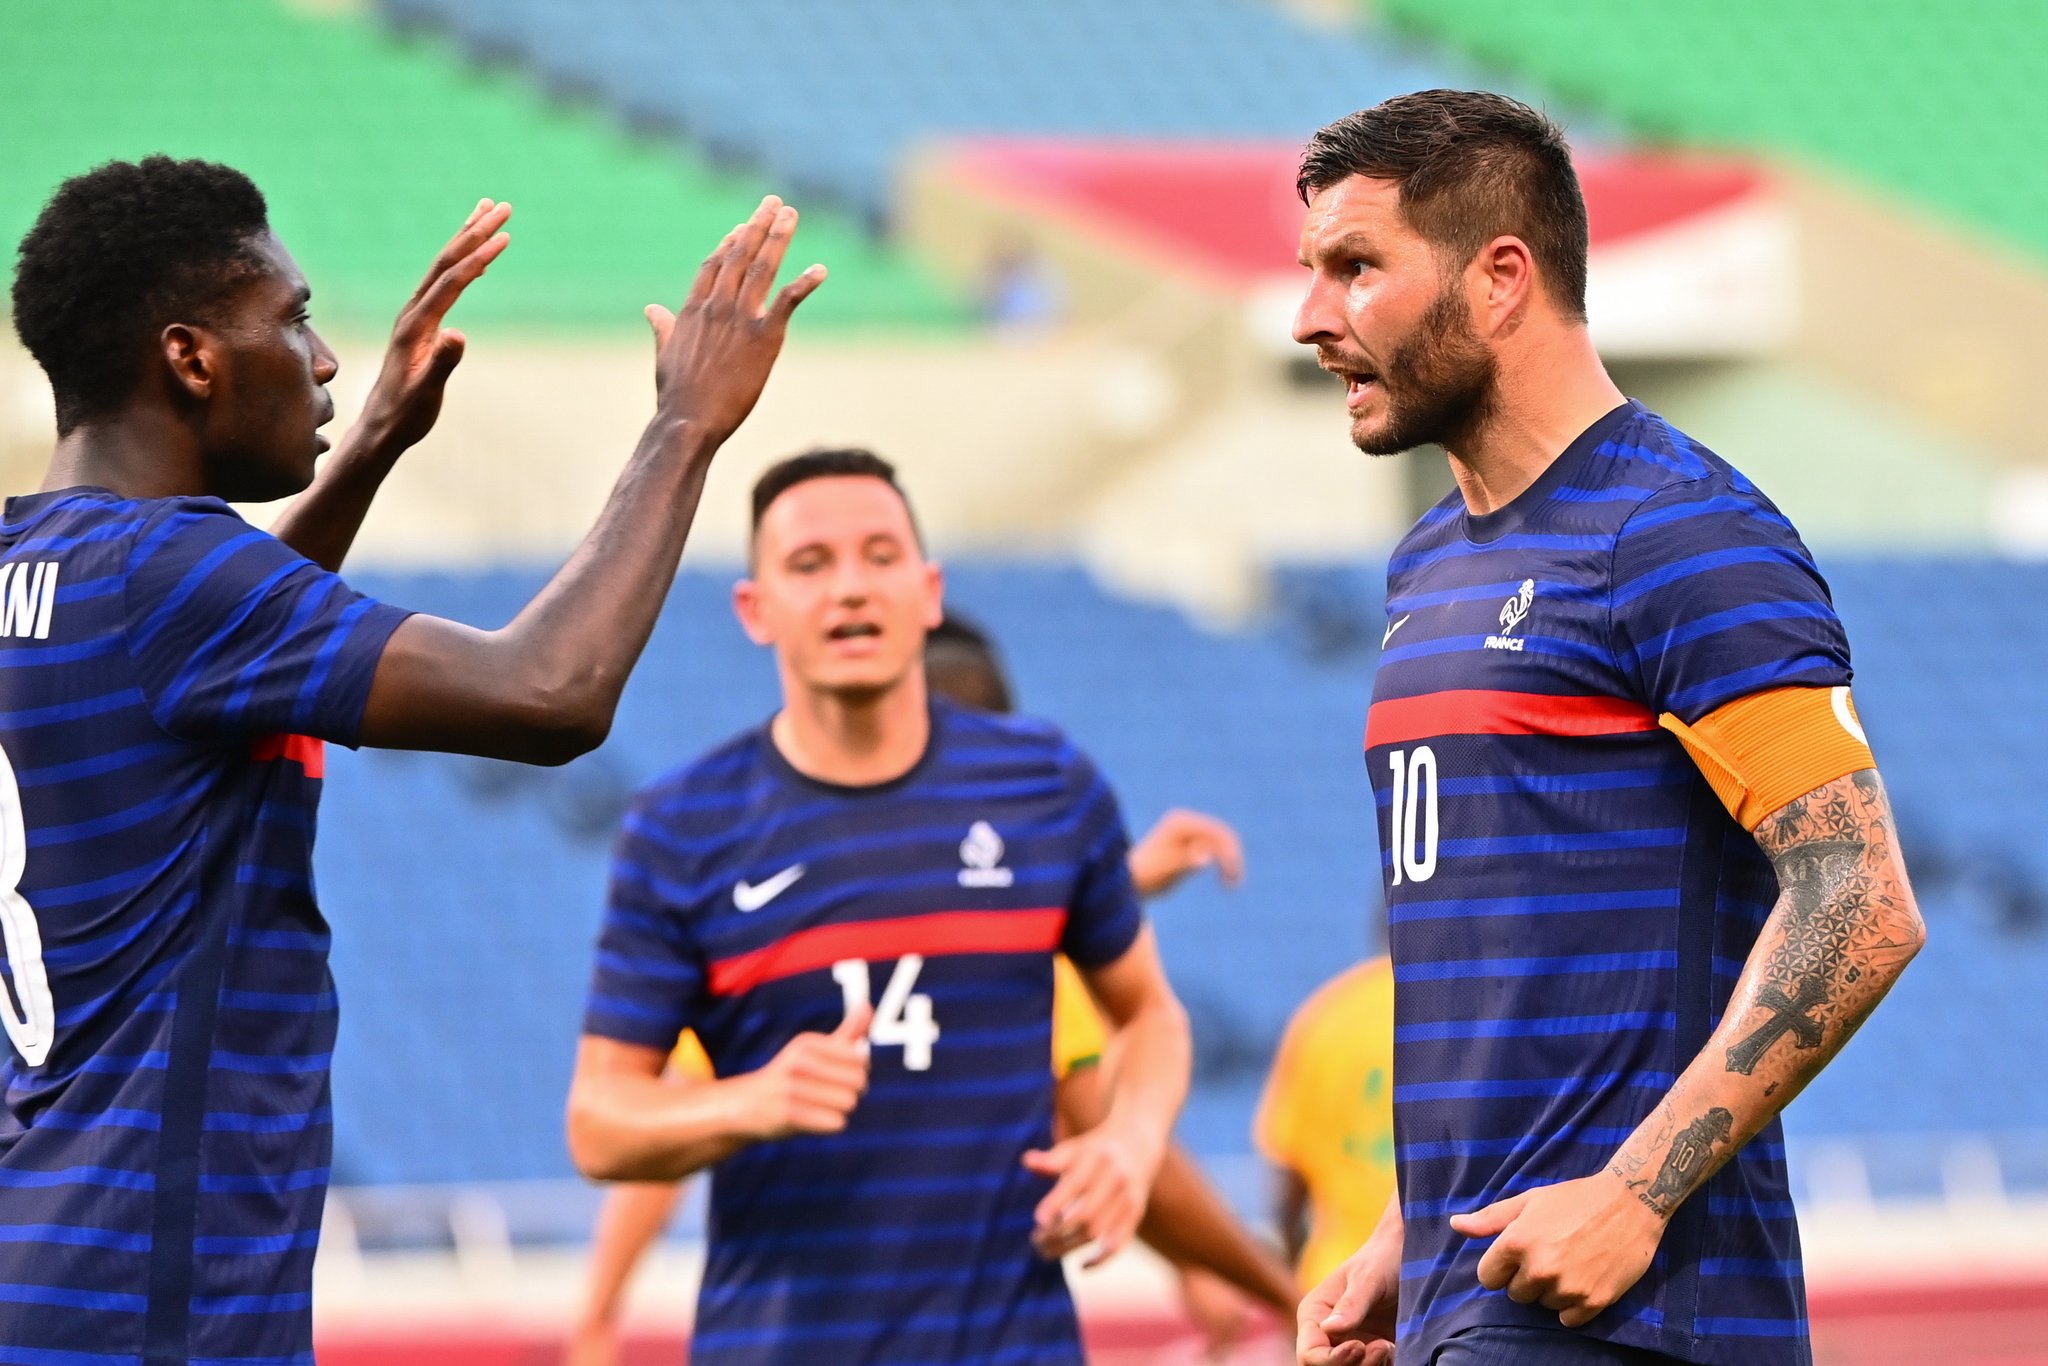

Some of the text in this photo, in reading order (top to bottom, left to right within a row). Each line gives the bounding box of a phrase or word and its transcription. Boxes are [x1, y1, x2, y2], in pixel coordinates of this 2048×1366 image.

[1484, 635, 1525, 652] FRANCE
[1389, 745, 1438, 886] 10
[832, 953, 940, 1071] 14
[1671, 1141, 1695, 1172] 10
